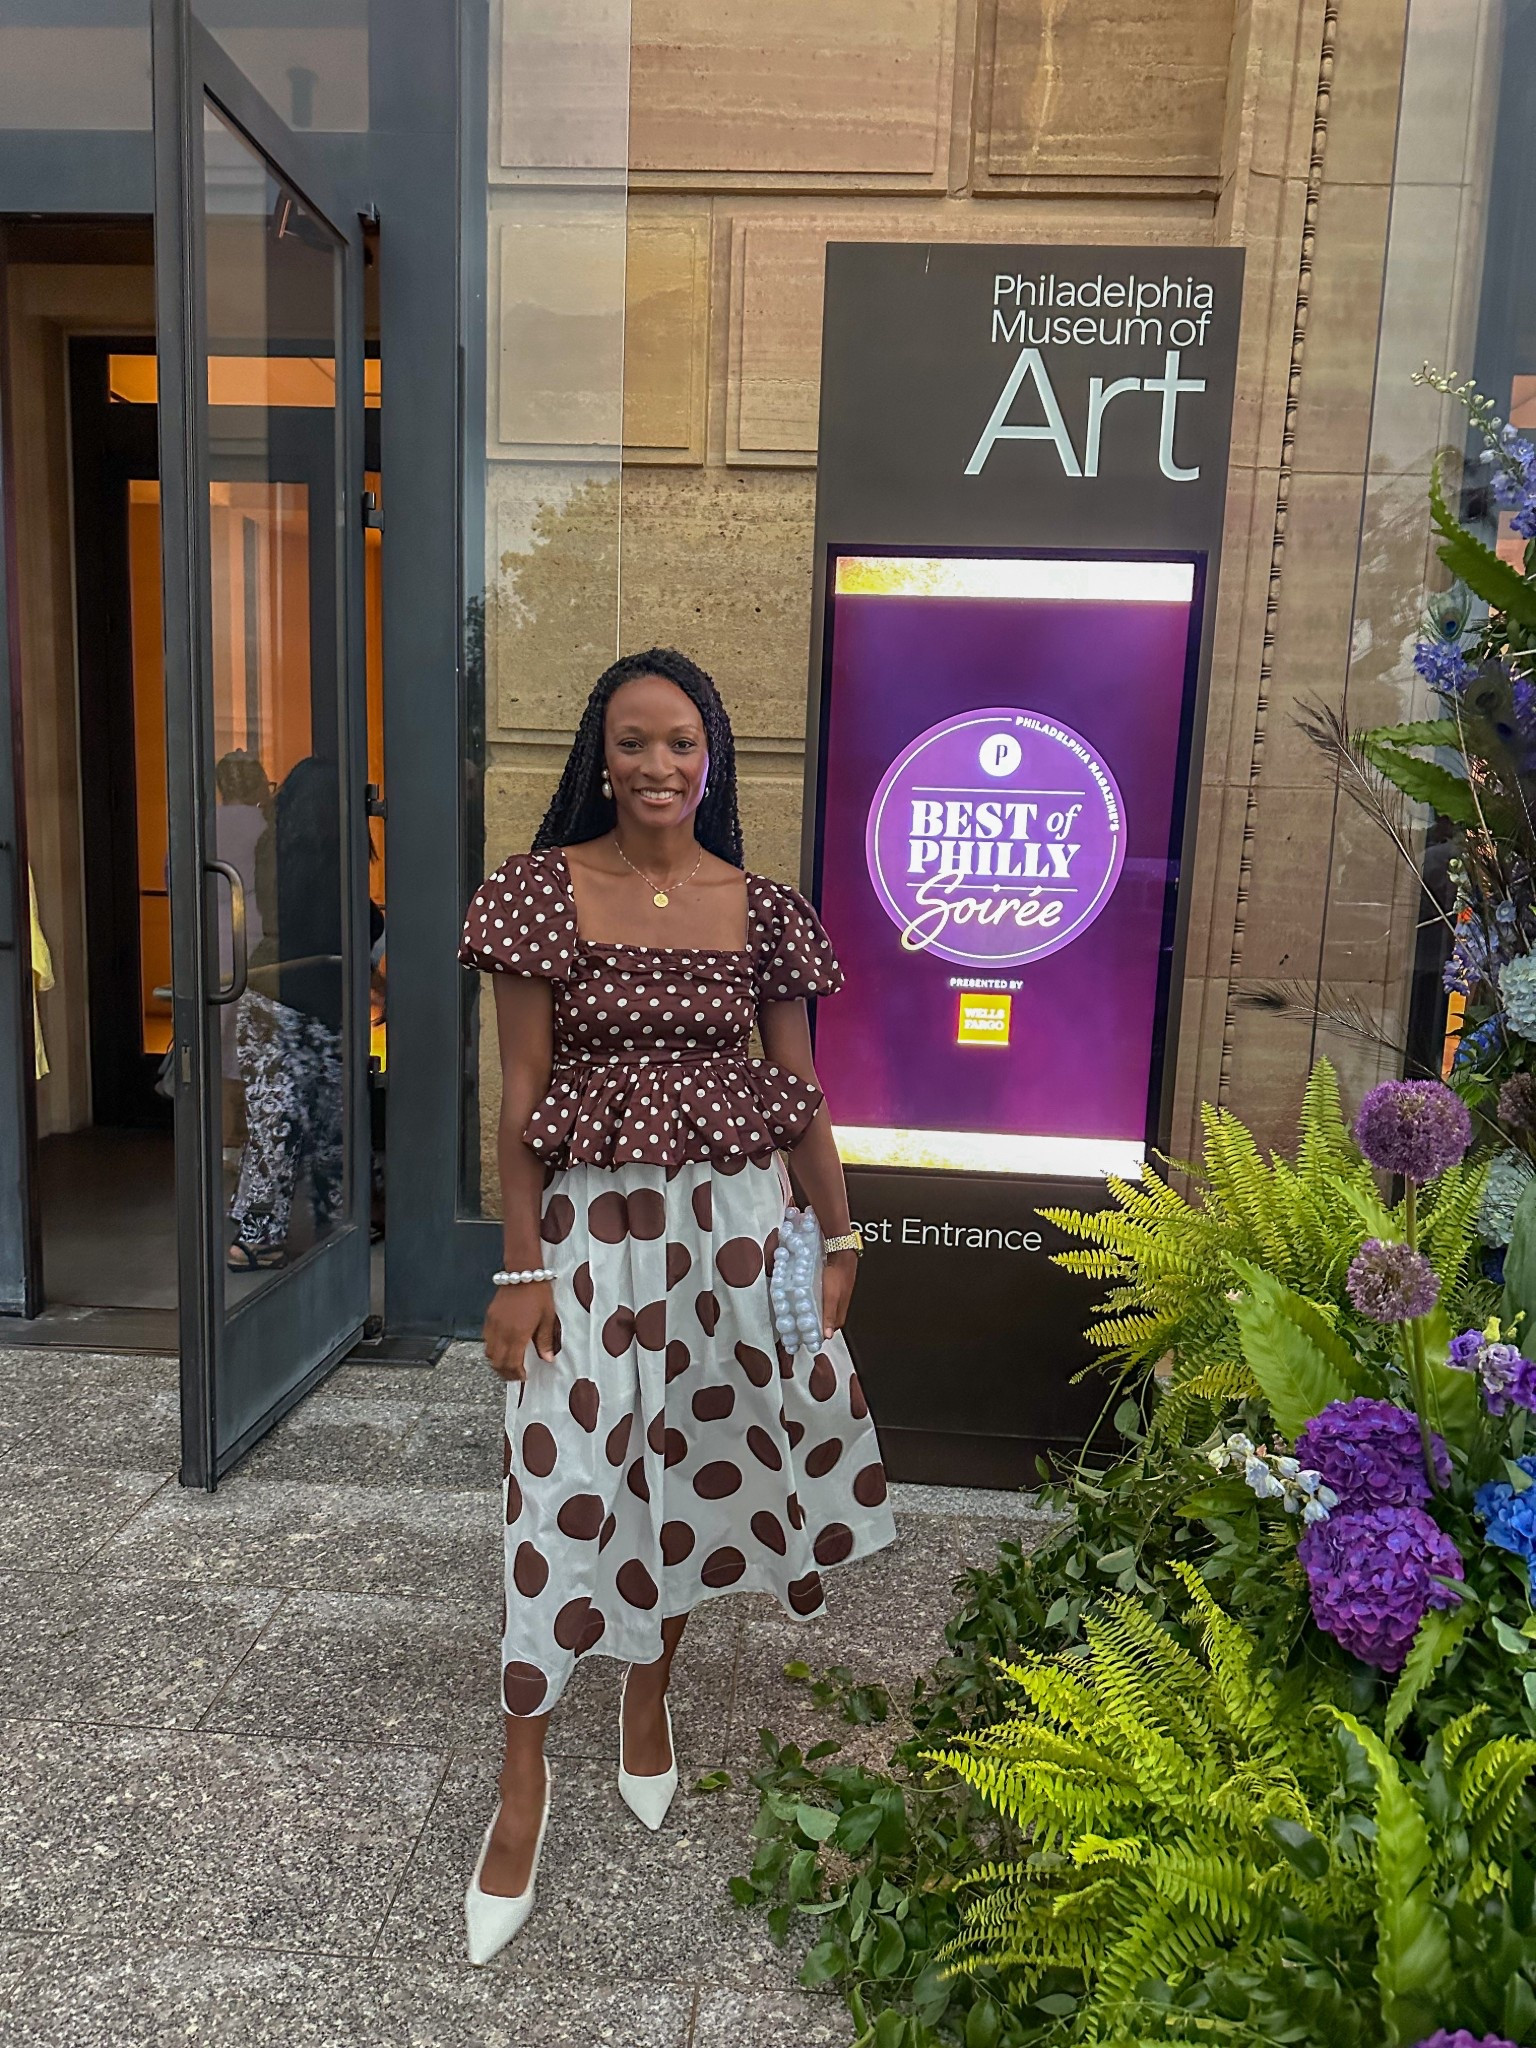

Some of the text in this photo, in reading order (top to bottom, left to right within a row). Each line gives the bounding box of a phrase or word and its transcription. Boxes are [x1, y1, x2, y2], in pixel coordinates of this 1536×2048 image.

[993, 274, 1214, 316] Philadelphia
[991, 309, 1213, 347] Museum of
[963, 347, 1207, 482] Art
[1015, 716, 1120, 832] PHILADELPHIA MAGAZINE'S
[908, 800, 1083, 841] BEST of
[907, 839, 1082, 878] PHILLY
[901, 872, 1065, 951] Soirée
[949, 977, 1024, 990] PRESENTED BY
[964, 1007, 1005, 1020] WELLS
[964, 1019, 1005, 1031] FARGO
[849, 1218, 1043, 1252] est Entrance
